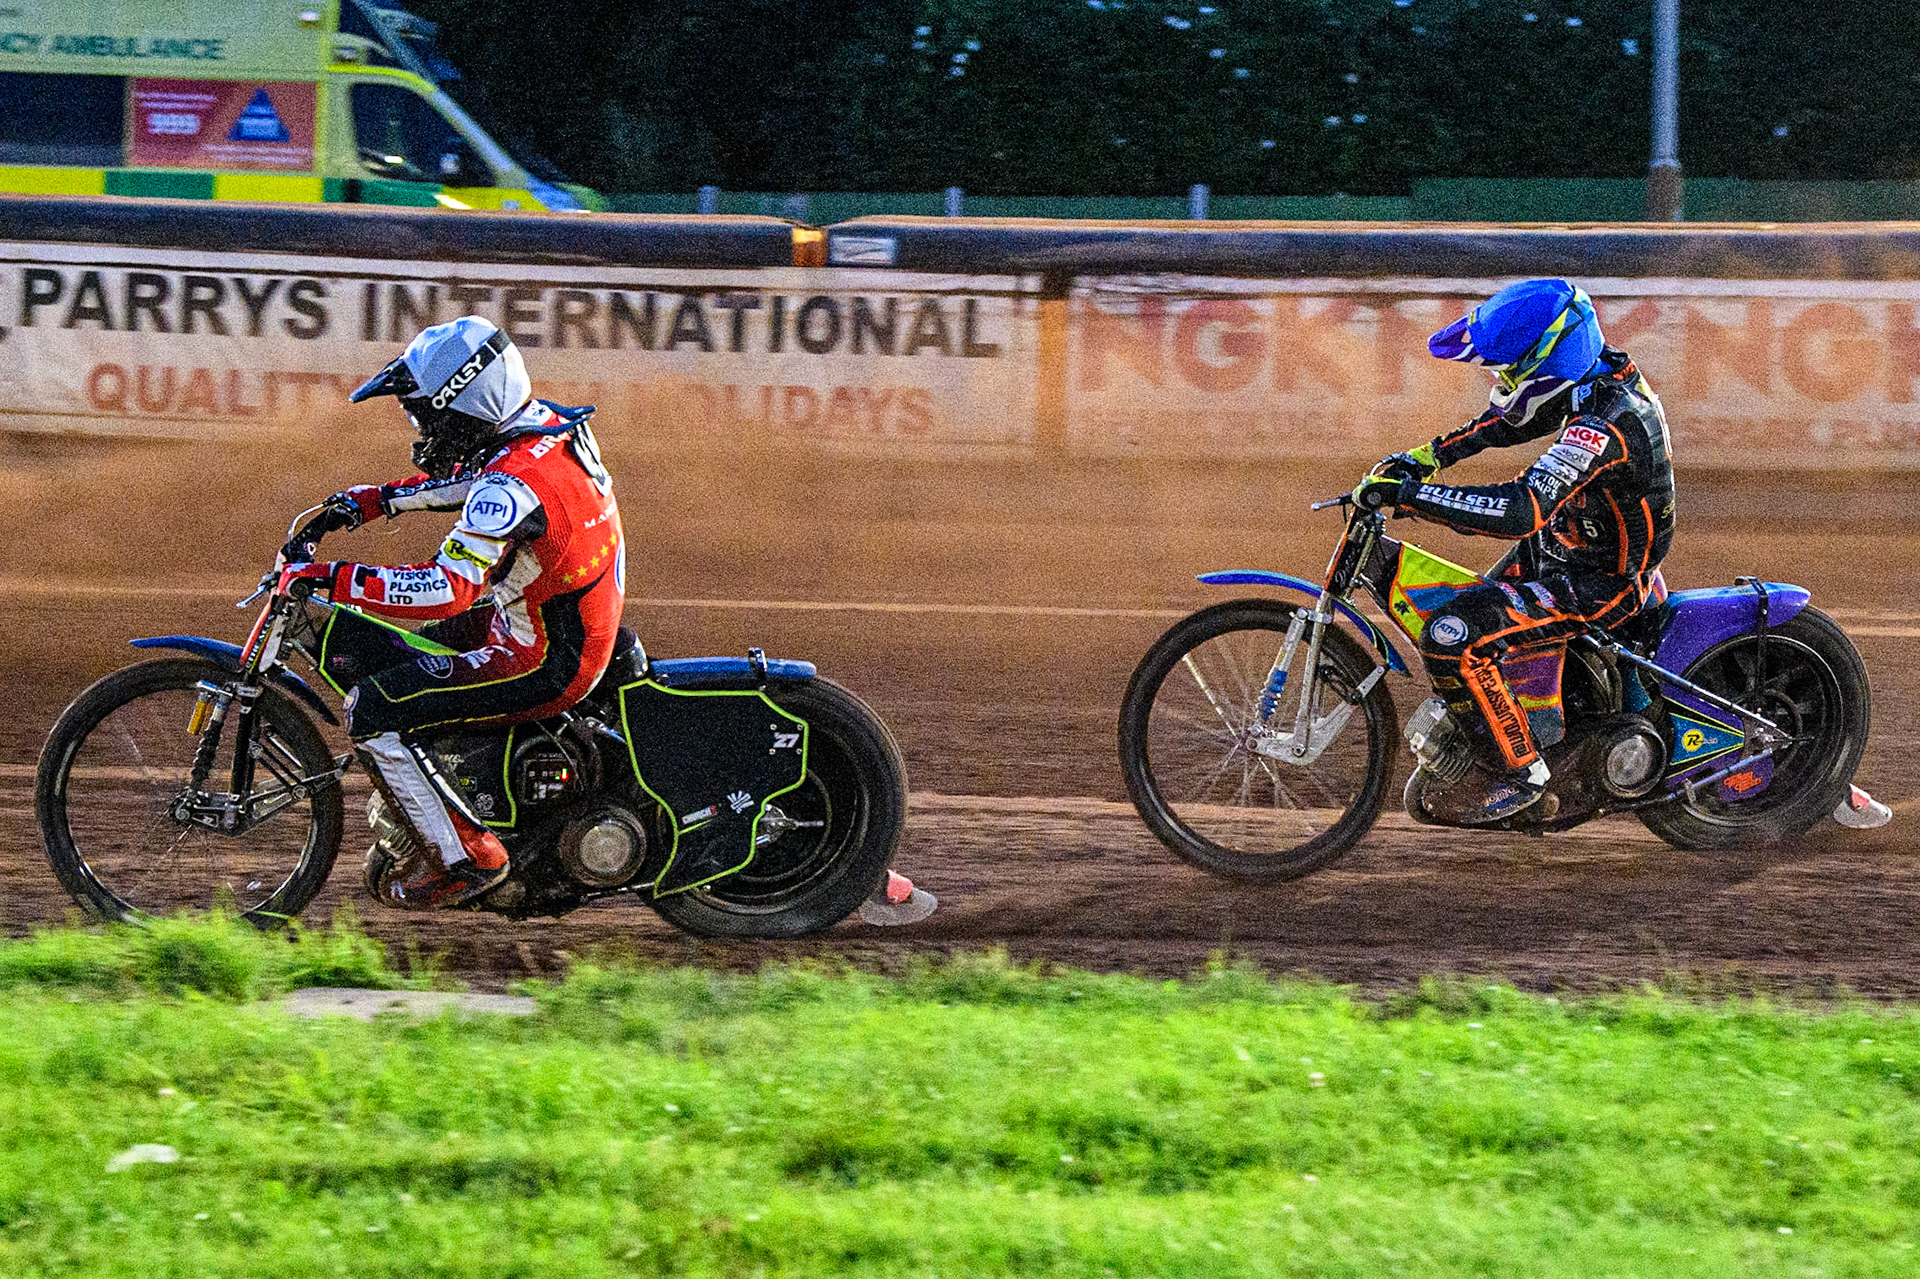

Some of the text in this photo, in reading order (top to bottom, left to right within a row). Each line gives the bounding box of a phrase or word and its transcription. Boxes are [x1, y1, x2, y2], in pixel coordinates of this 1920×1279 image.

[53, 34, 224, 60] AMBULANCE
[20, 267, 1000, 358] PARRYS INTERNATIONAL
[1076, 297, 1352, 397] NGK
[431, 354, 484, 410] OAKLEY
[1565, 427, 1605, 449] NGK
[1420, 484, 1511, 511] BULLSEYE
[1528, 475, 1558, 500] SKIPS
[472, 500, 508, 518] ATPI
[389, 578, 448, 593] PLASTICS
[392, 569, 432, 581] VISION
[388, 594, 413, 605] LTD
[1436, 618, 1460, 638] ATPI
[773, 732, 800, 748] 27
